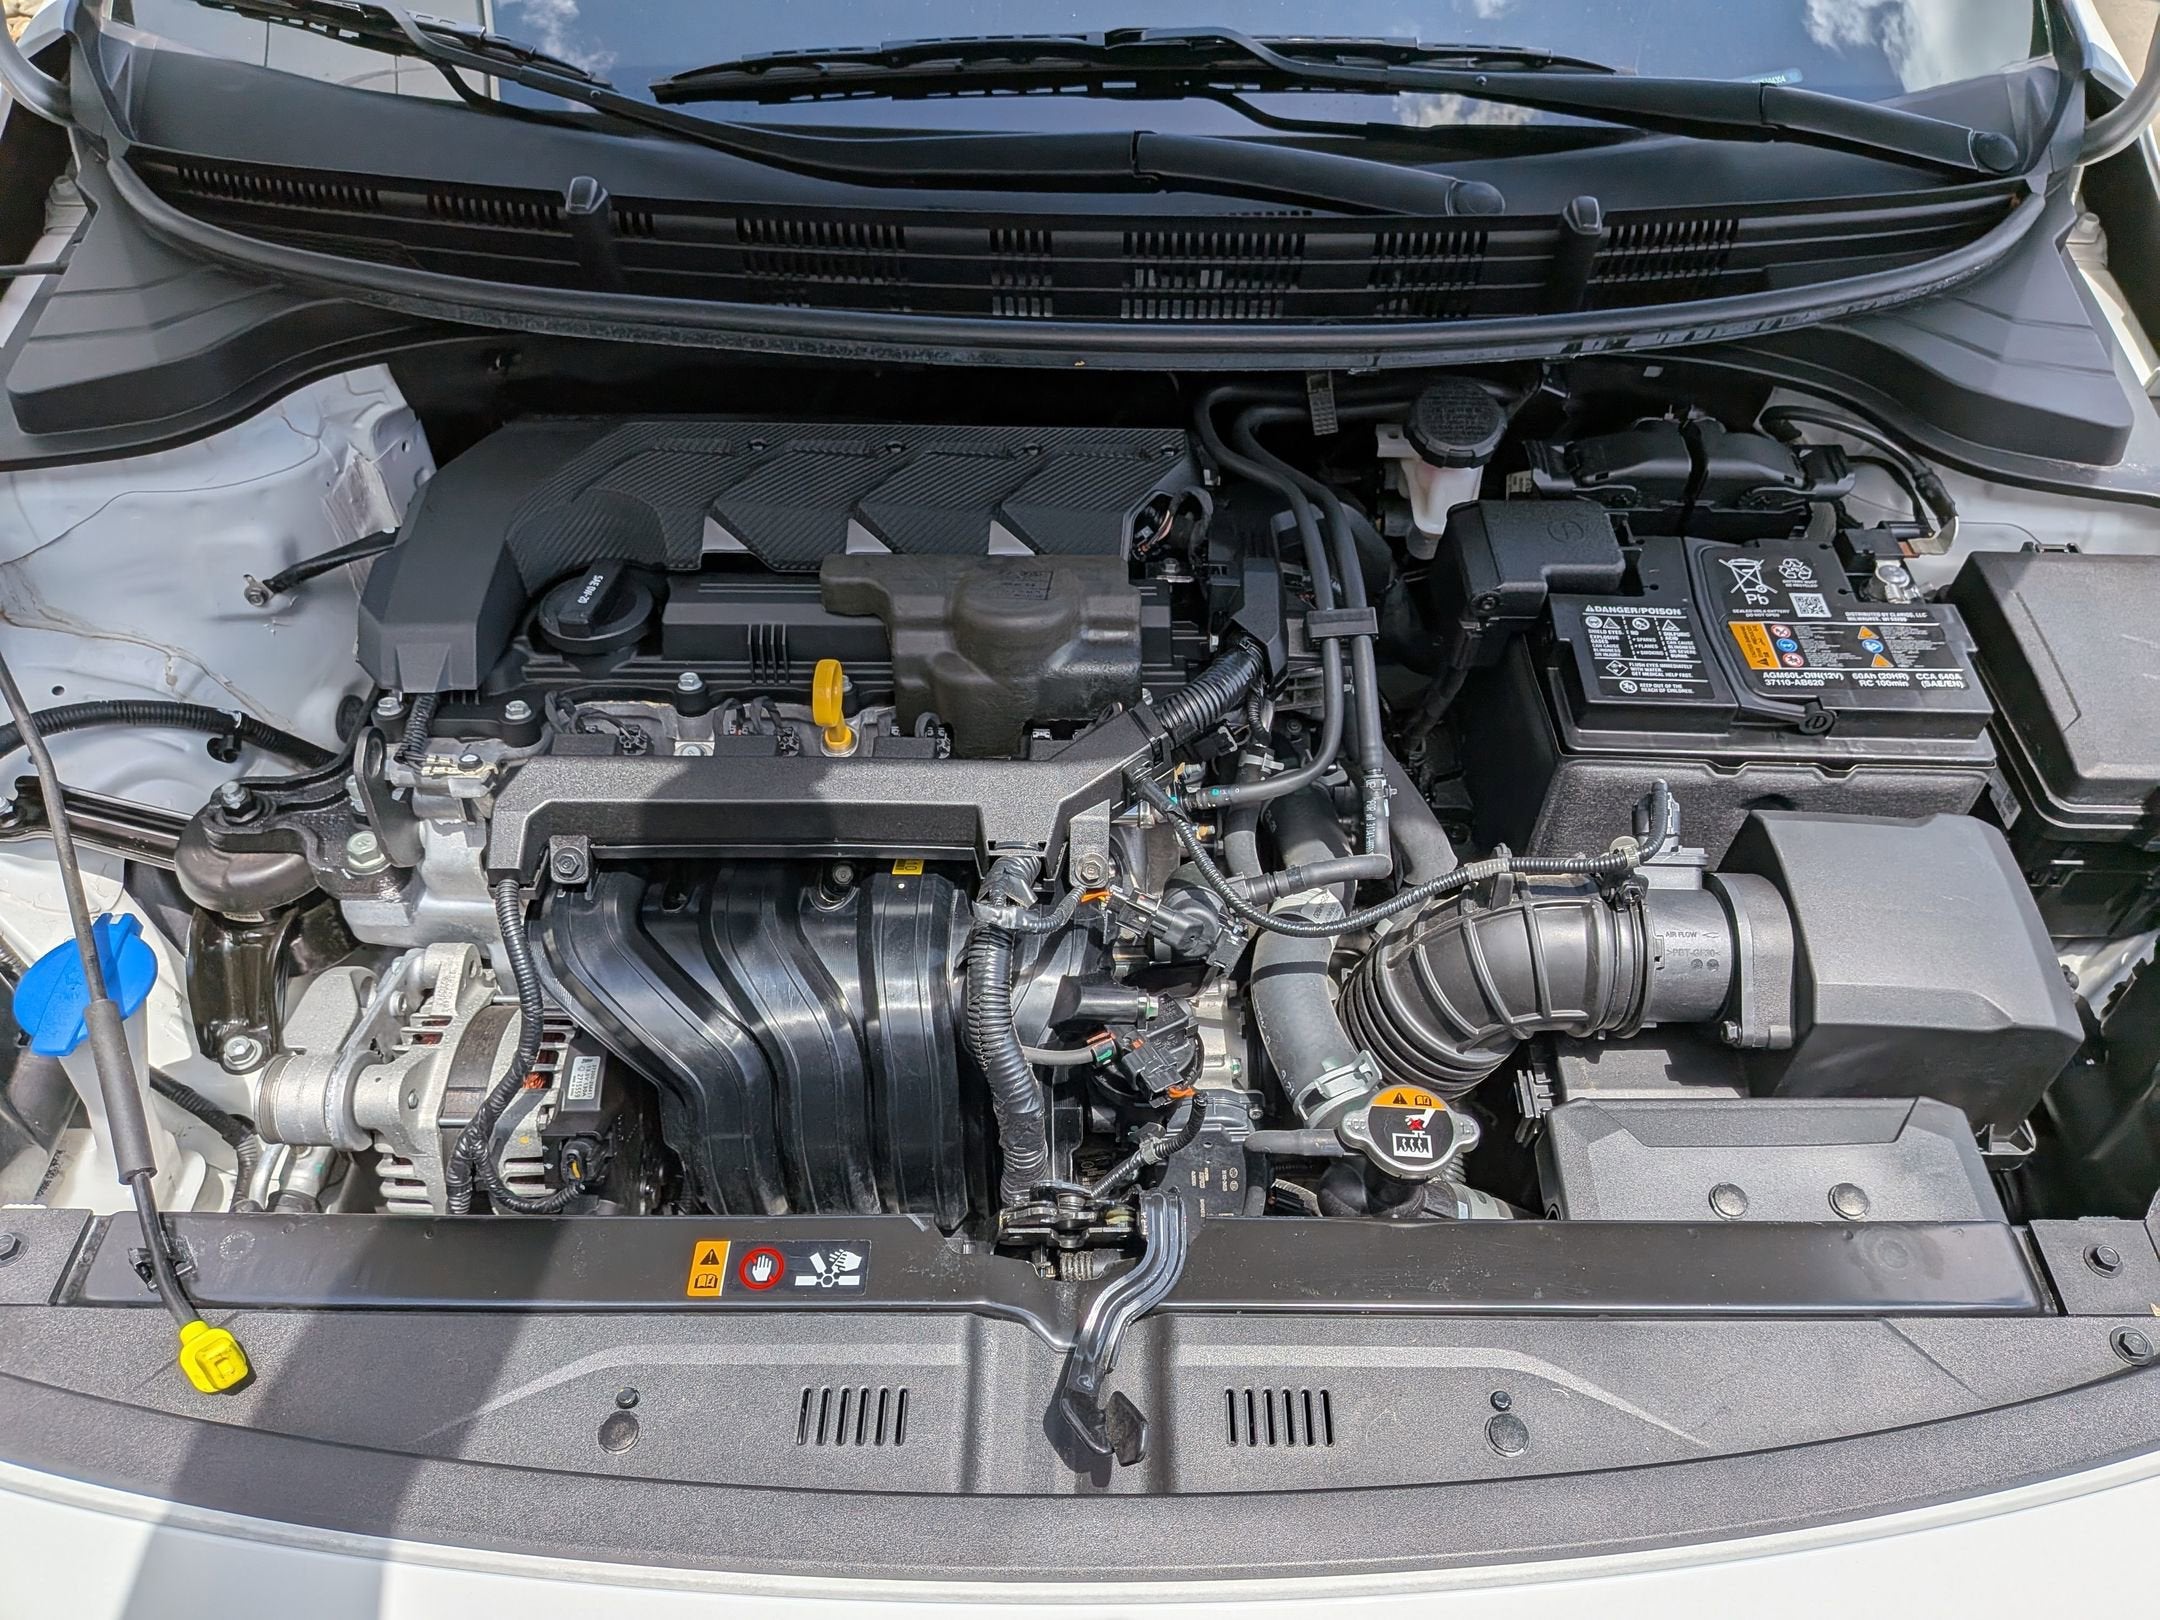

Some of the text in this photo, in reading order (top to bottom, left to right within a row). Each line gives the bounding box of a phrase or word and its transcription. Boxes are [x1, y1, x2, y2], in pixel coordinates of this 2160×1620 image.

[1745, 593, 1769, 605] Pb
[1594, 606, 1682, 615] DANGER/POISON
[1878, 673, 1910, 681] (20HR)
[1921, 680, 1965, 688] (SAE/EN)
